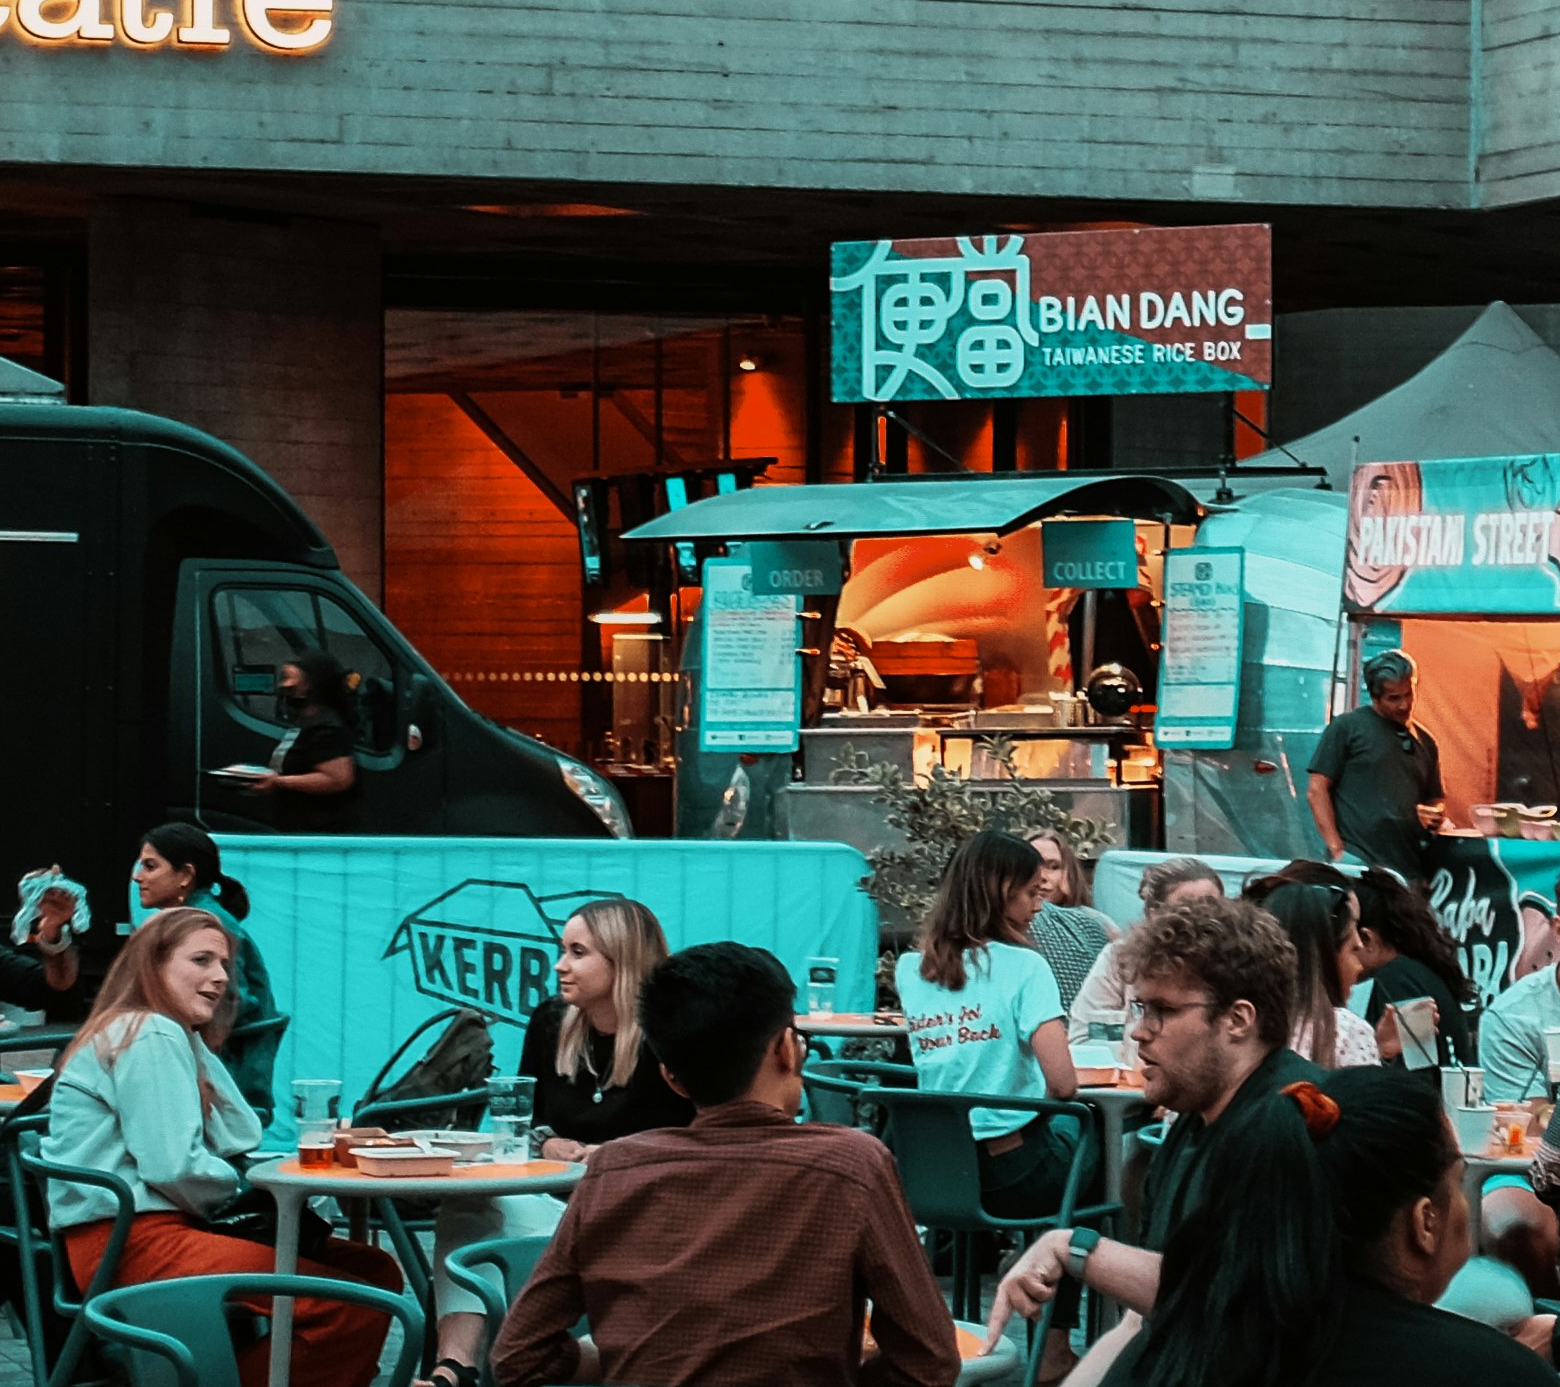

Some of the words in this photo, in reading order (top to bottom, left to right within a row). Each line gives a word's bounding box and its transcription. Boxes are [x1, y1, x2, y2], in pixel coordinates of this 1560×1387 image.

[1039, 294, 1131, 333] BIAN
[1140, 288, 1245, 330] DANG
[1042, 345, 1144, 366] TAIWANESE
[1152, 343, 1194, 363] RICE
[1203, 341, 1241, 362] BOX
[1471, 511, 1555, 565] STREET
[769, 569, 825, 589] ORDER
[1052, 561, 1128, 581] COLLECT
[417, 931, 553, 1018] KERB
